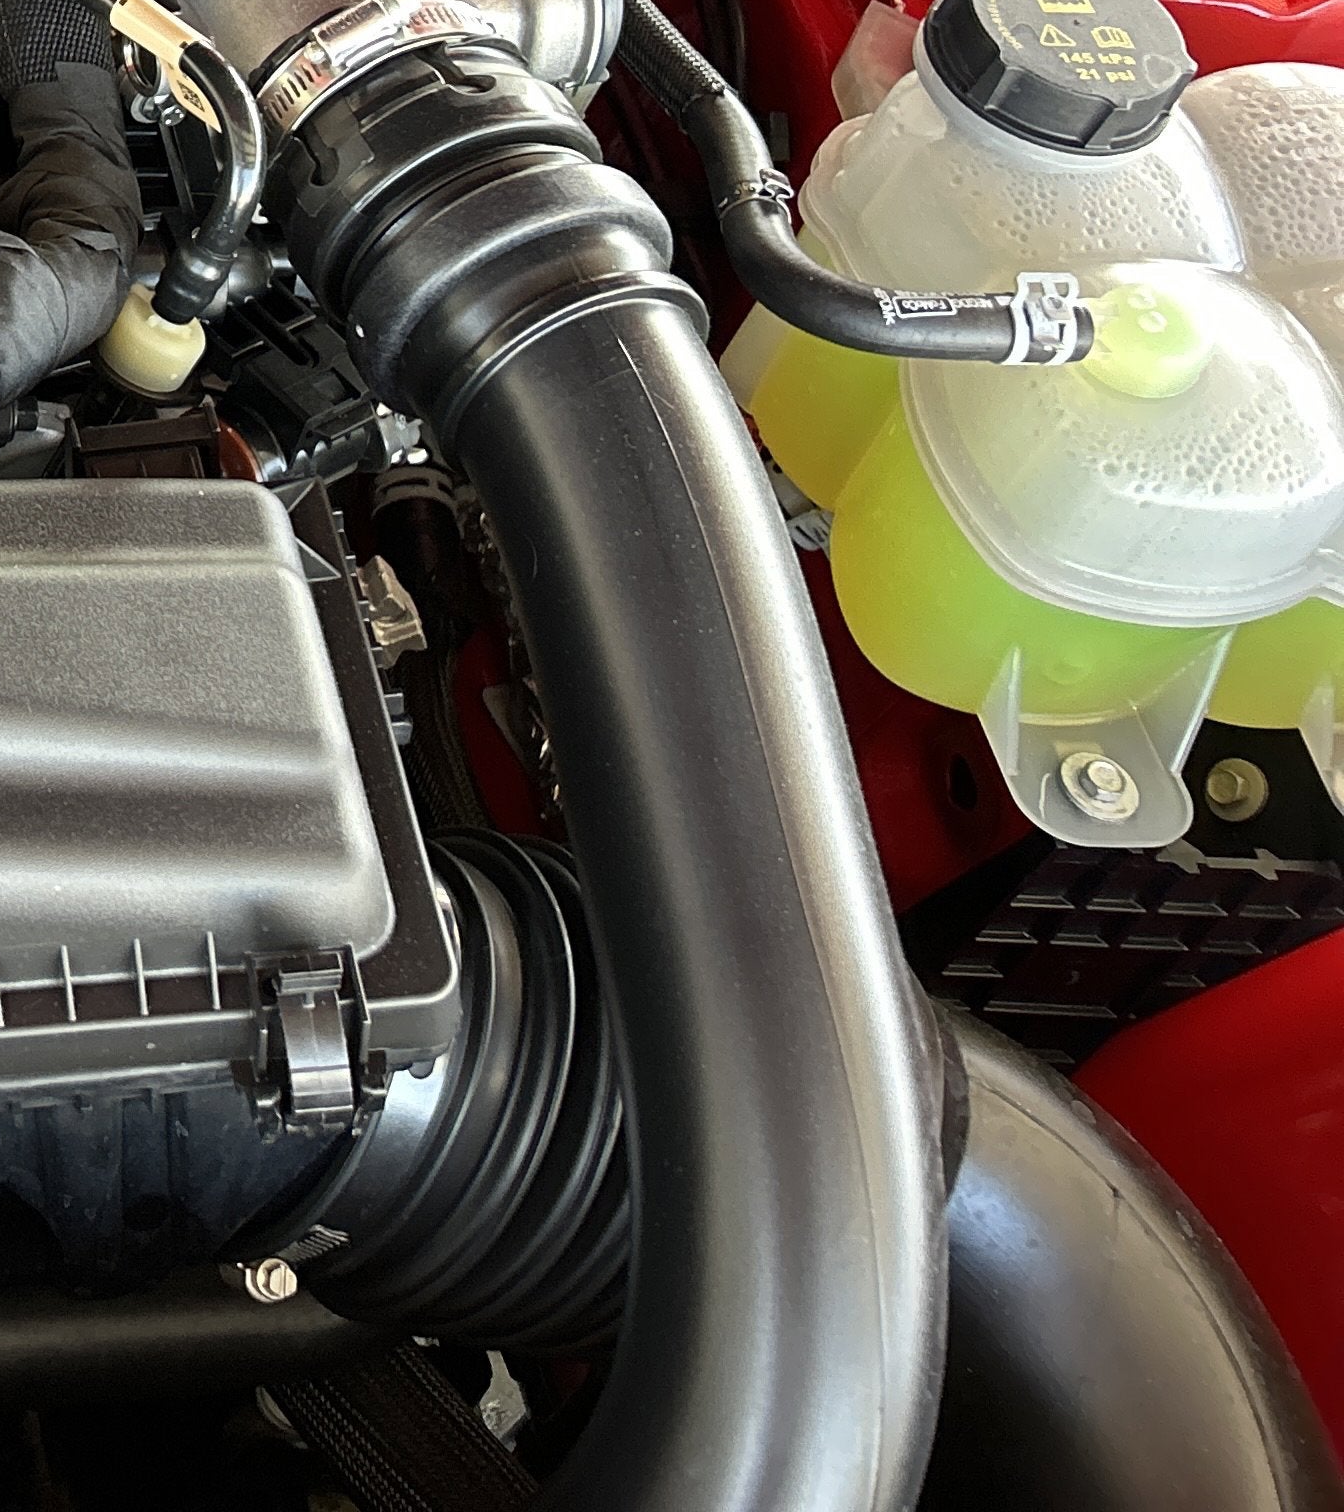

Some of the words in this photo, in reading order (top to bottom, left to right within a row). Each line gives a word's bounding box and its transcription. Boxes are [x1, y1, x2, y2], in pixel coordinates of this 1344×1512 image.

[1058, 51, 1096, 65] 145
[1098, 53, 1137, 66] kPa
[1075, 68, 1101, 81] 21
[1106, 69, 1136, 84] psi
